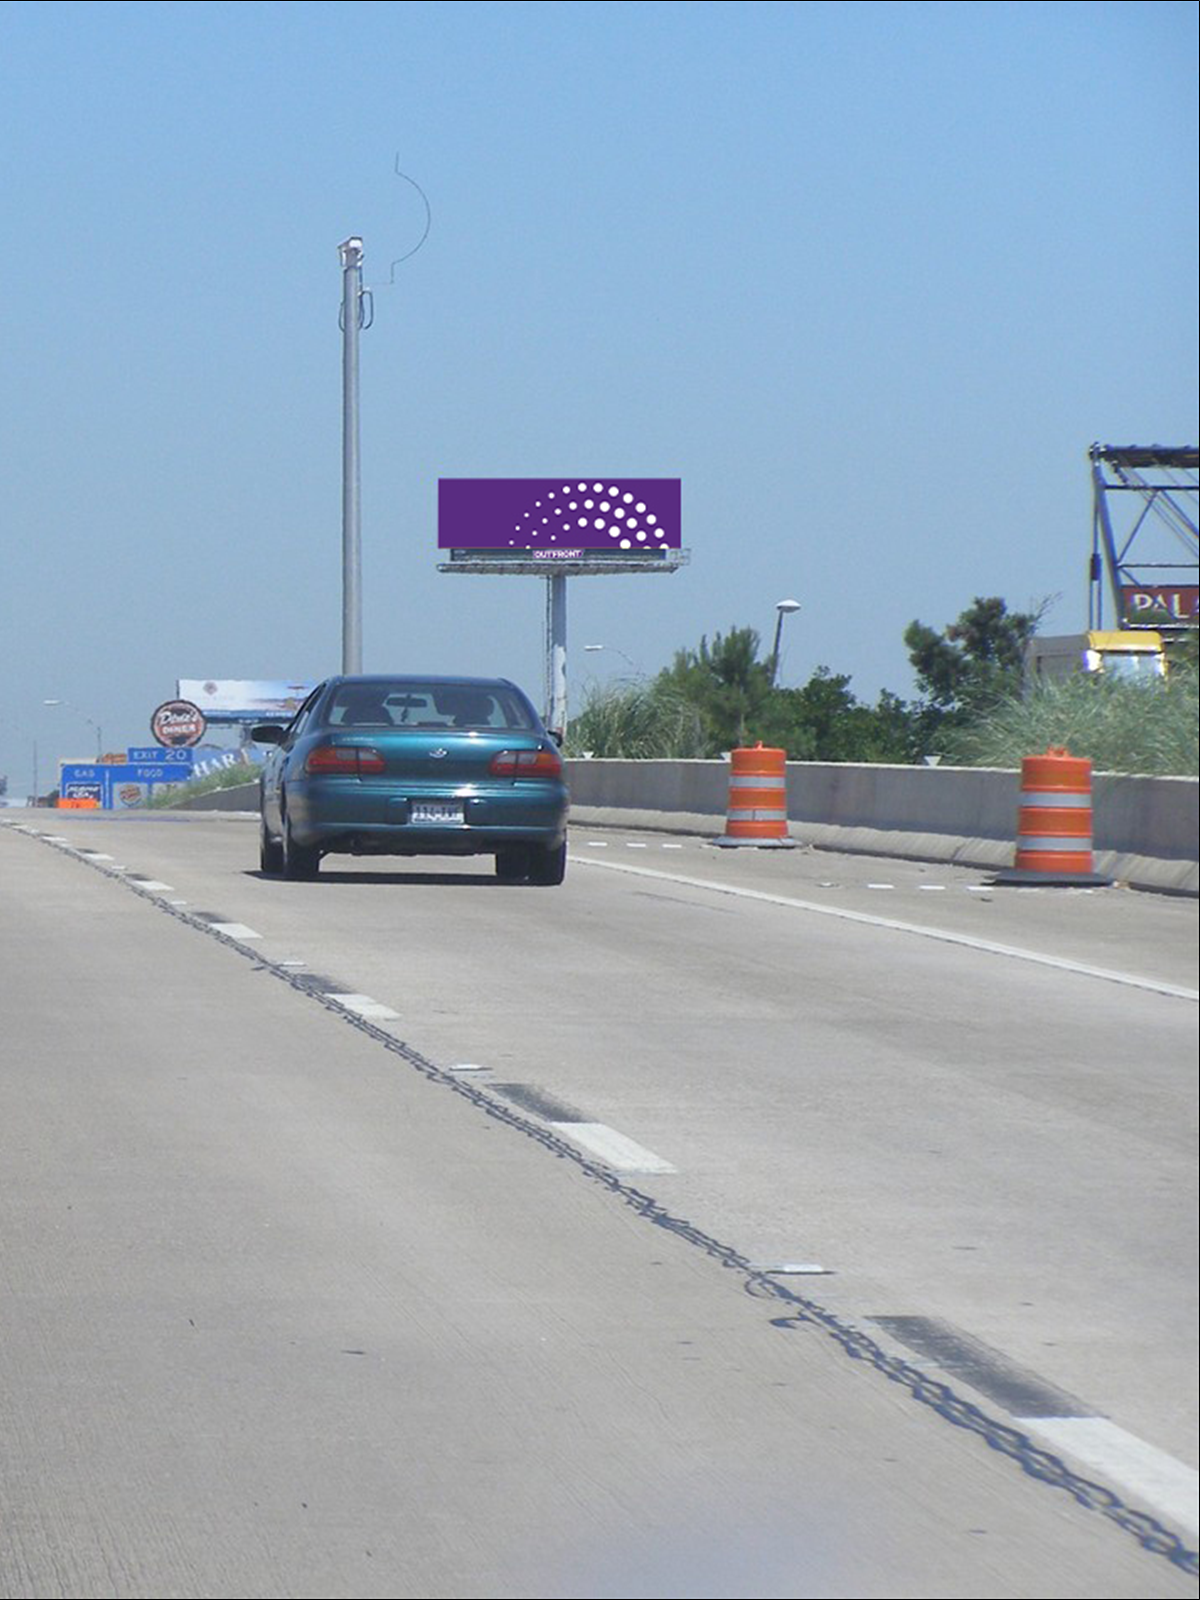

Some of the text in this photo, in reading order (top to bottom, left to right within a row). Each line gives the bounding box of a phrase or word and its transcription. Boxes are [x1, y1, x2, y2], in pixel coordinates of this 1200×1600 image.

[1133, 593, 1199, 619] PAL
[133, 749, 187, 760] EXIT 20
